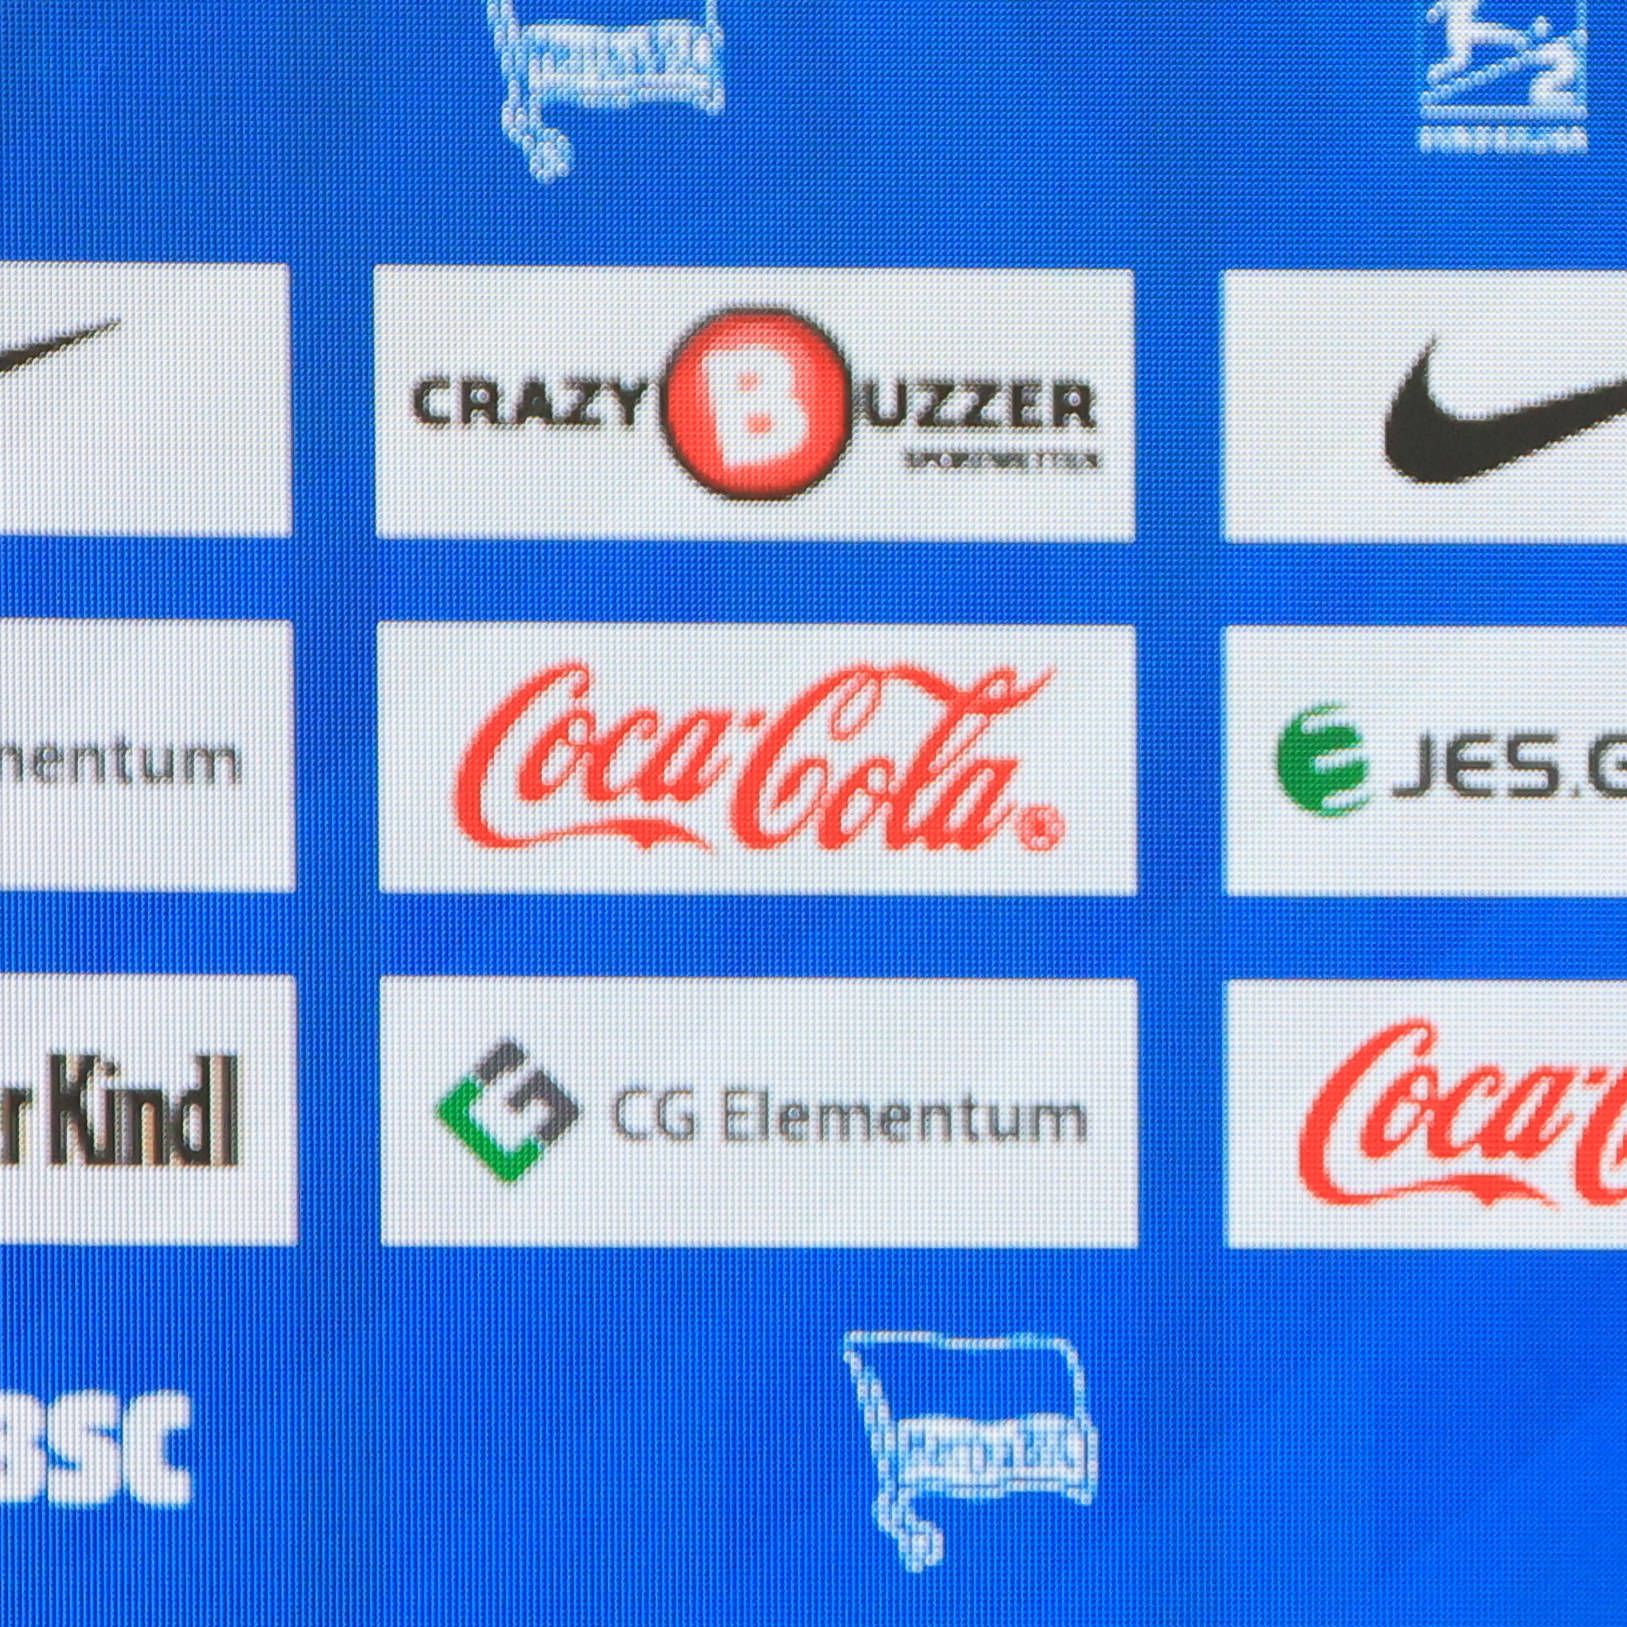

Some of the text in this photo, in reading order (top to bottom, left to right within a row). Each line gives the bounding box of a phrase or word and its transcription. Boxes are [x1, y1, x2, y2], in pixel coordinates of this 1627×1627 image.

[412, 376, 650, 430] CRAZY
[49, 1054, 239, 1165] Kindl
[613, 1085, 1089, 1146] CG Elementum
